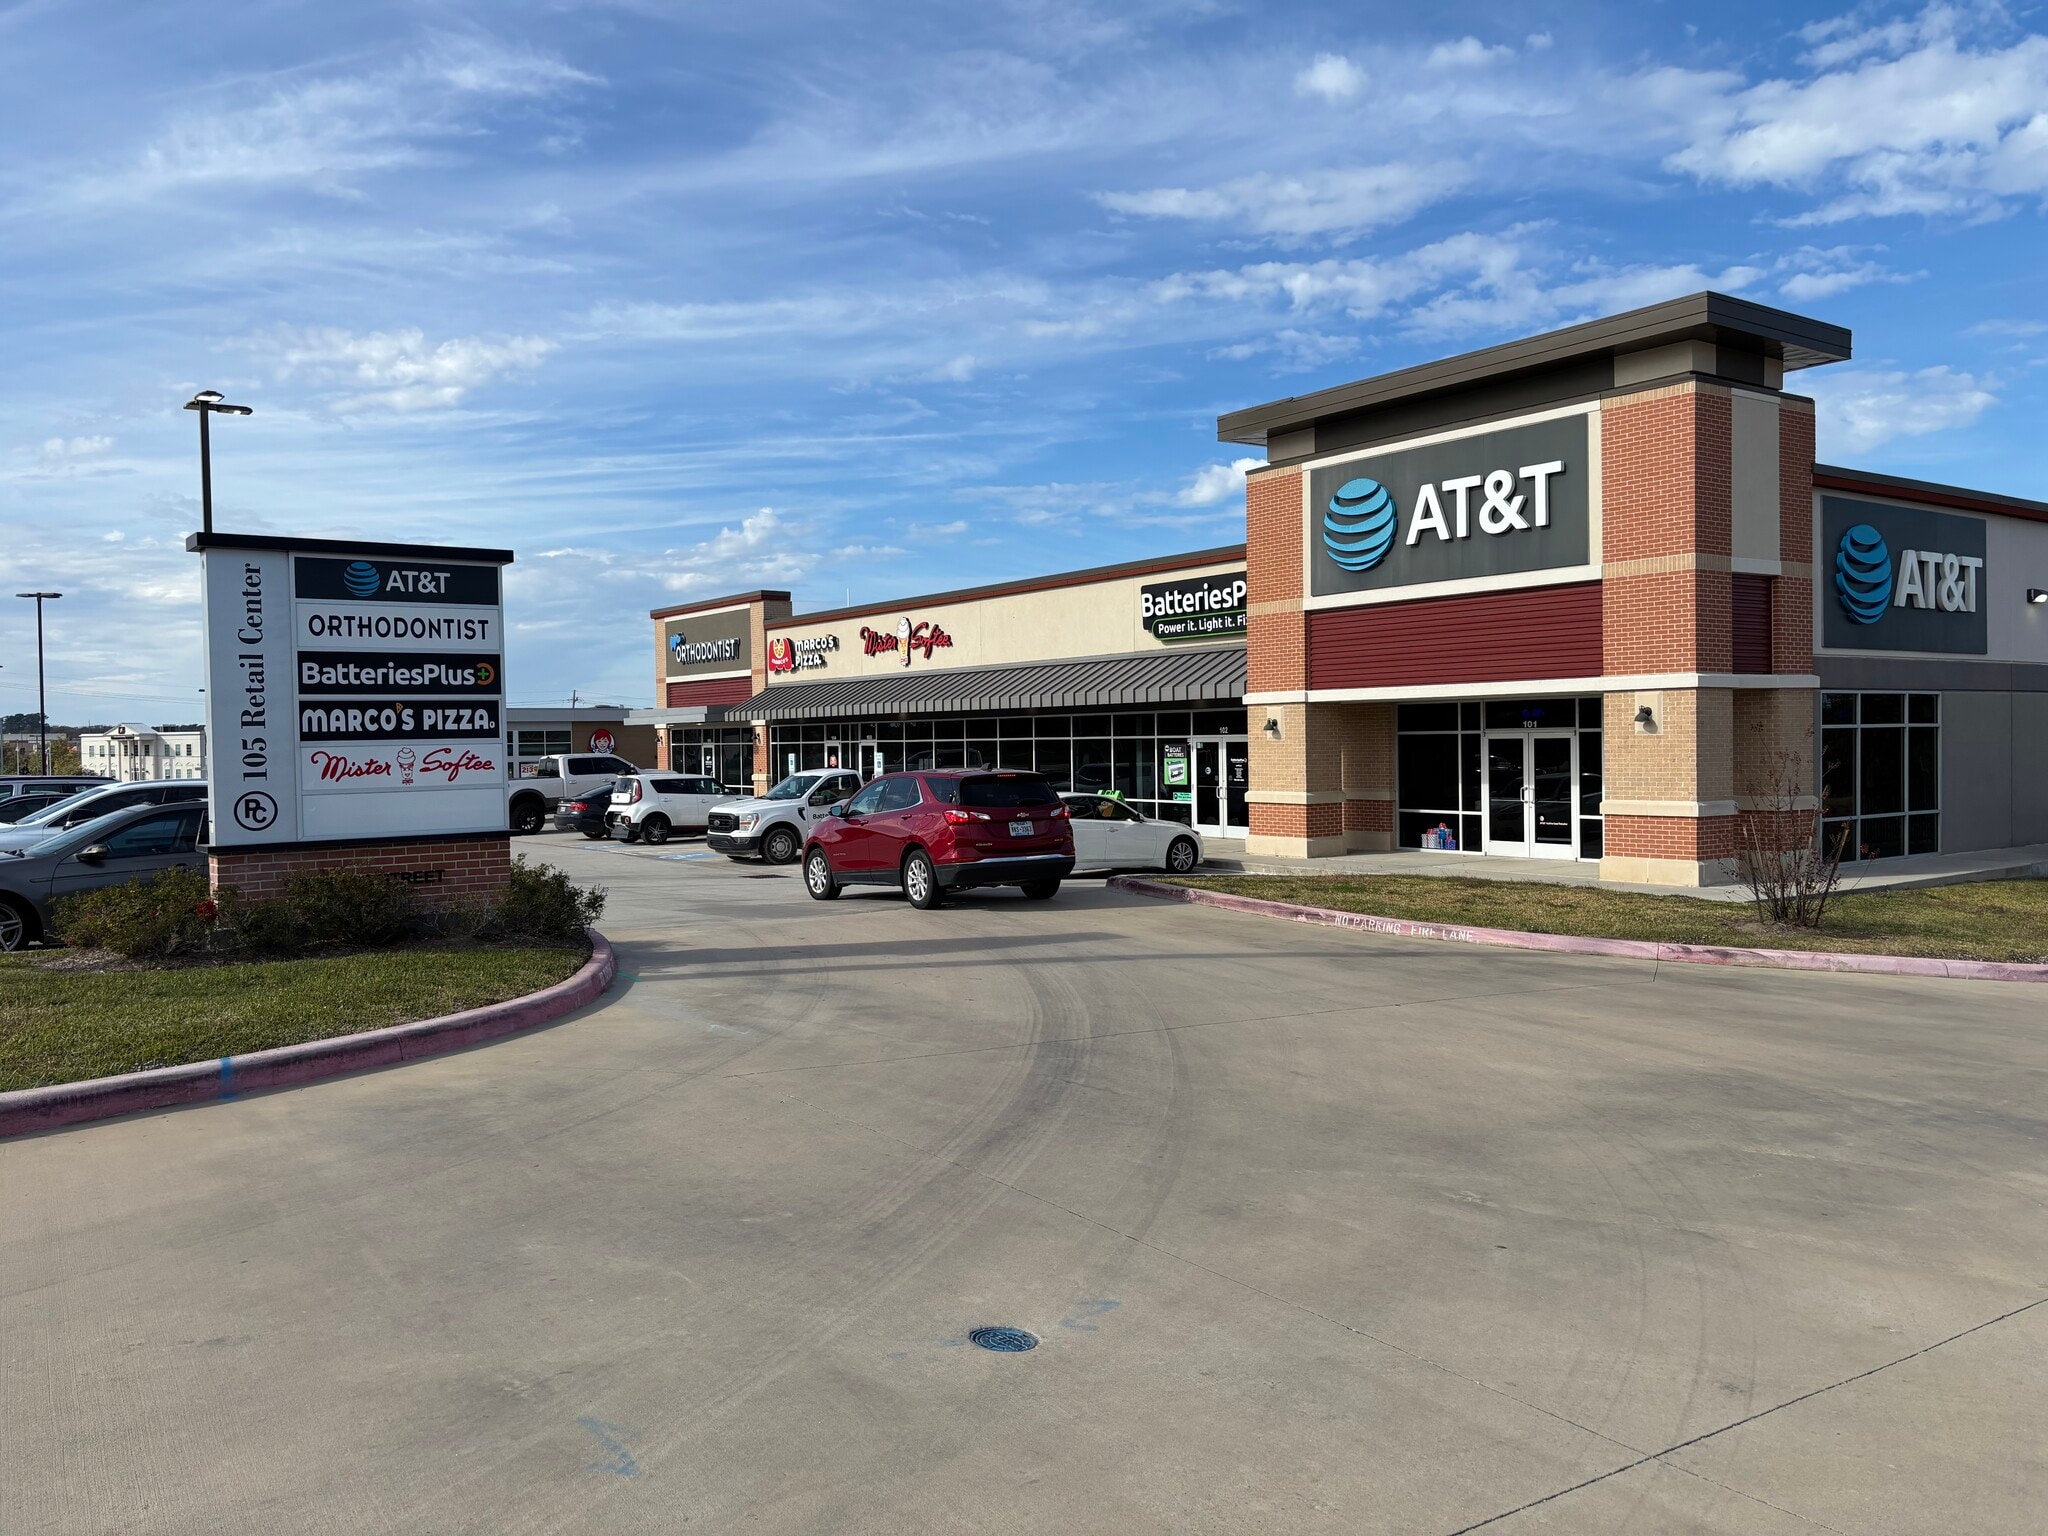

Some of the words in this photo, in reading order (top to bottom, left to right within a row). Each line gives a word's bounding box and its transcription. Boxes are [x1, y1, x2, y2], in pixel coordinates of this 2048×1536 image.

[1406, 460, 1565, 546] AT&T
[385, 570, 451, 594] AT&T
[1894, 549, 1983, 613] AT&T
[237, 562, 264, 645] Center
[1141, 580, 1247, 618] BatteriesP
[308, 614, 489, 640] ORTHODONTIST
[860, 626, 898, 657] Mister
[910, 621, 952, 660] Softee
[1158, 623, 1185, 634] Power
[1187, 619, 1197, 631] it.
[1199, 617, 1222, 632] Light
[1225, 615, 1235, 628] it.
[675, 638, 739, 664] ORTHODONTIST
[302, 662, 476, 685] BatteriesPlus
[238, 653, 266, 729] Retail
[302, 703, 415, 732] MARCO'S
[1523, 720, 1537, 728] 101
[241, 737, 268, 782] 105
[311, 751, 392, 783] Mister
[419, 748, 495, 782] Softee
[1335, 915, 1349, 926] NO
[1353, 917, 1401, 934] PARKING
[1411, 924, 1436, 937] FIRE
[1442, 929, 1474, 942] LANE
